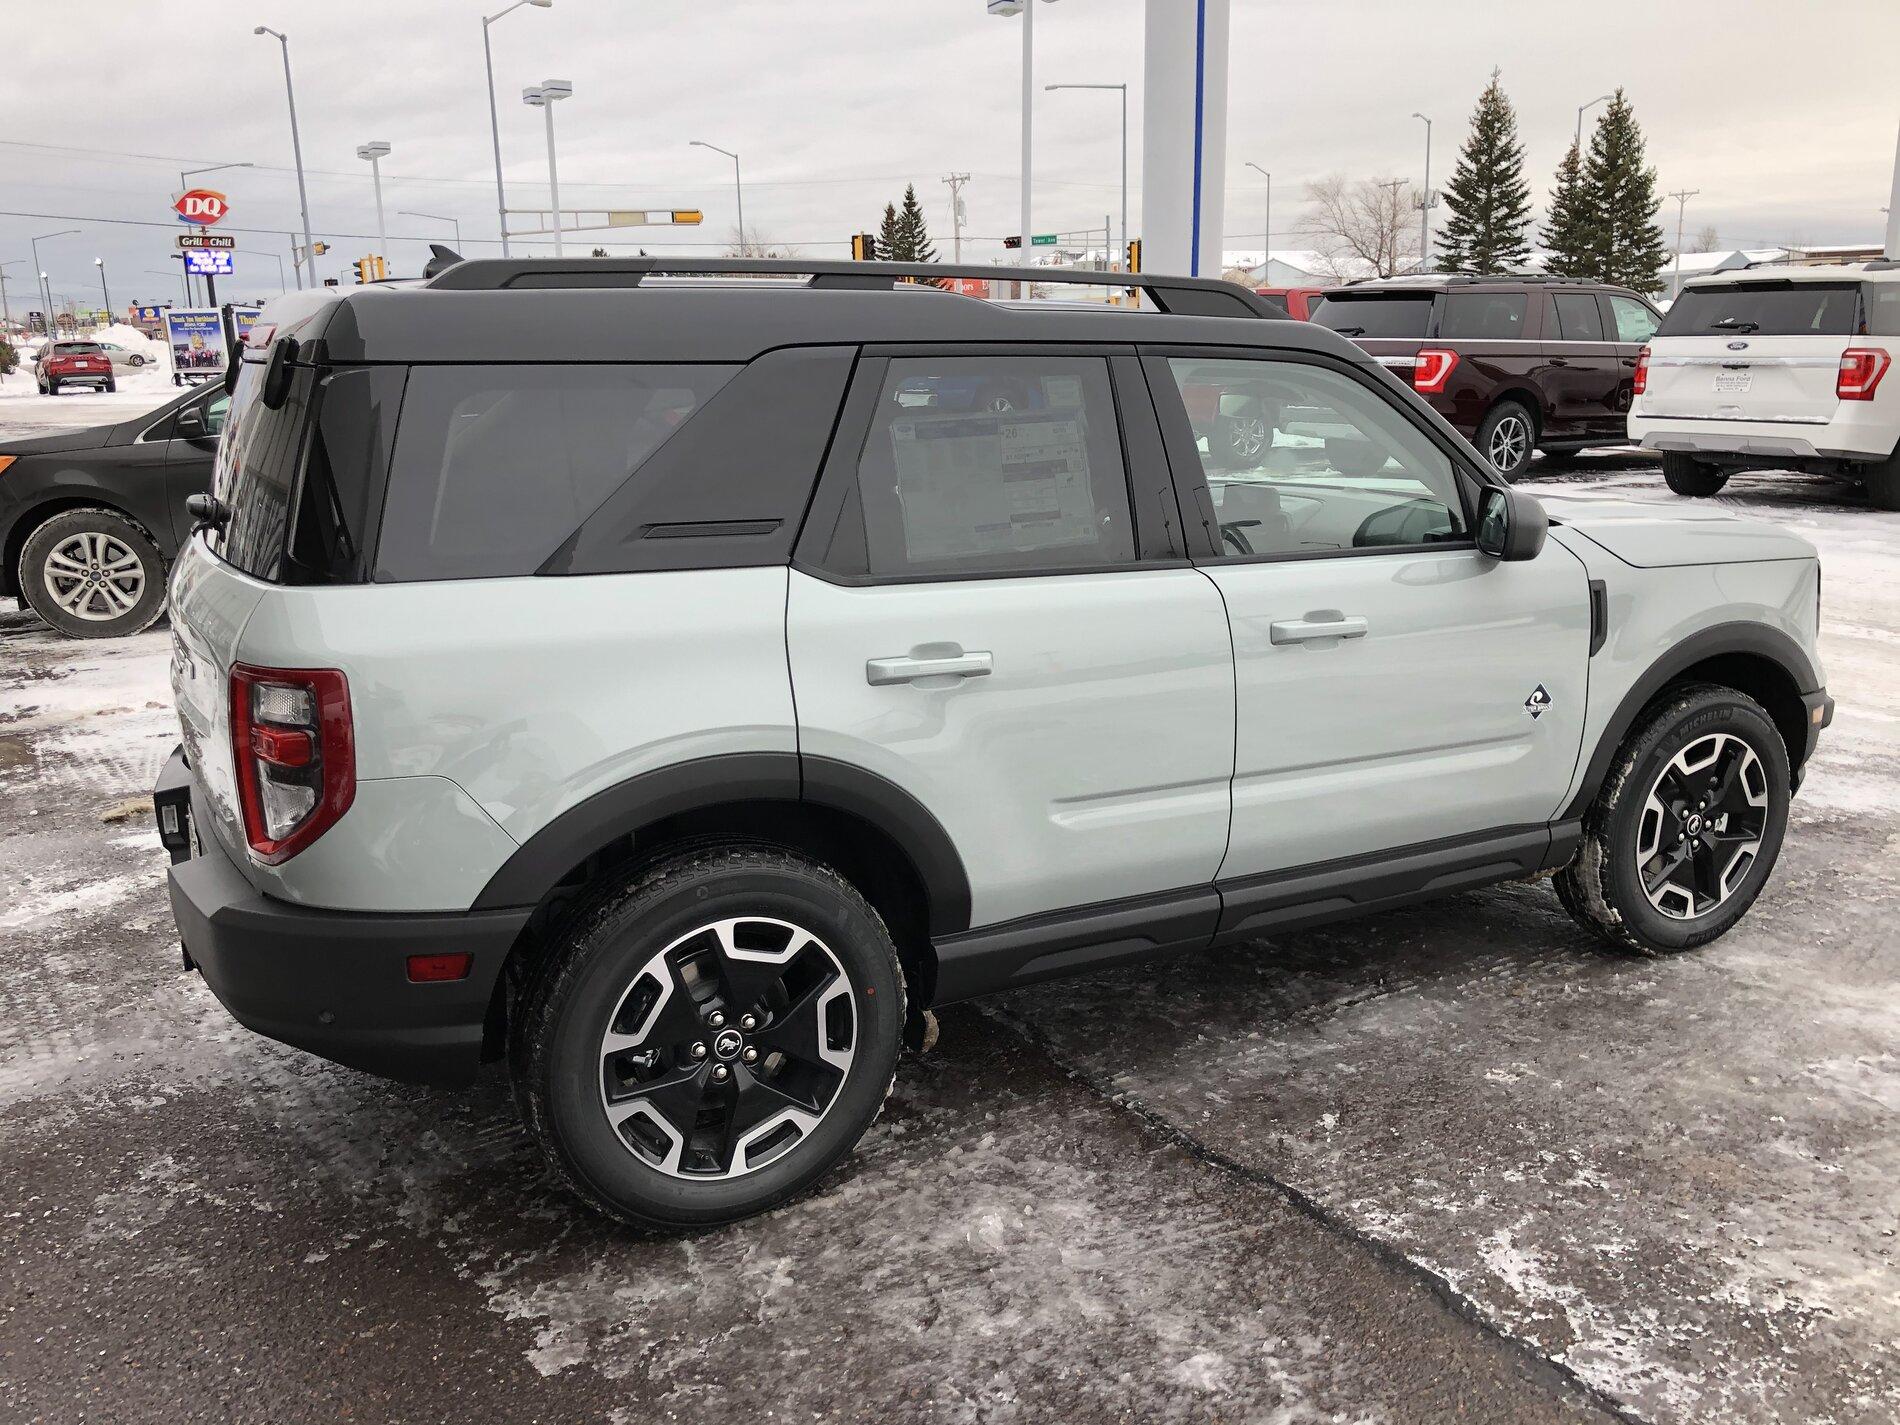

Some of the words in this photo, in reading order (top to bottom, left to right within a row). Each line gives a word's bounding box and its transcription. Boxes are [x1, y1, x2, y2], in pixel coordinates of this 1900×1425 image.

[185, 197, 221, 217] DQ
[182, 238, 203, 246] Grill
[210, 238, 232, 247] Chill
